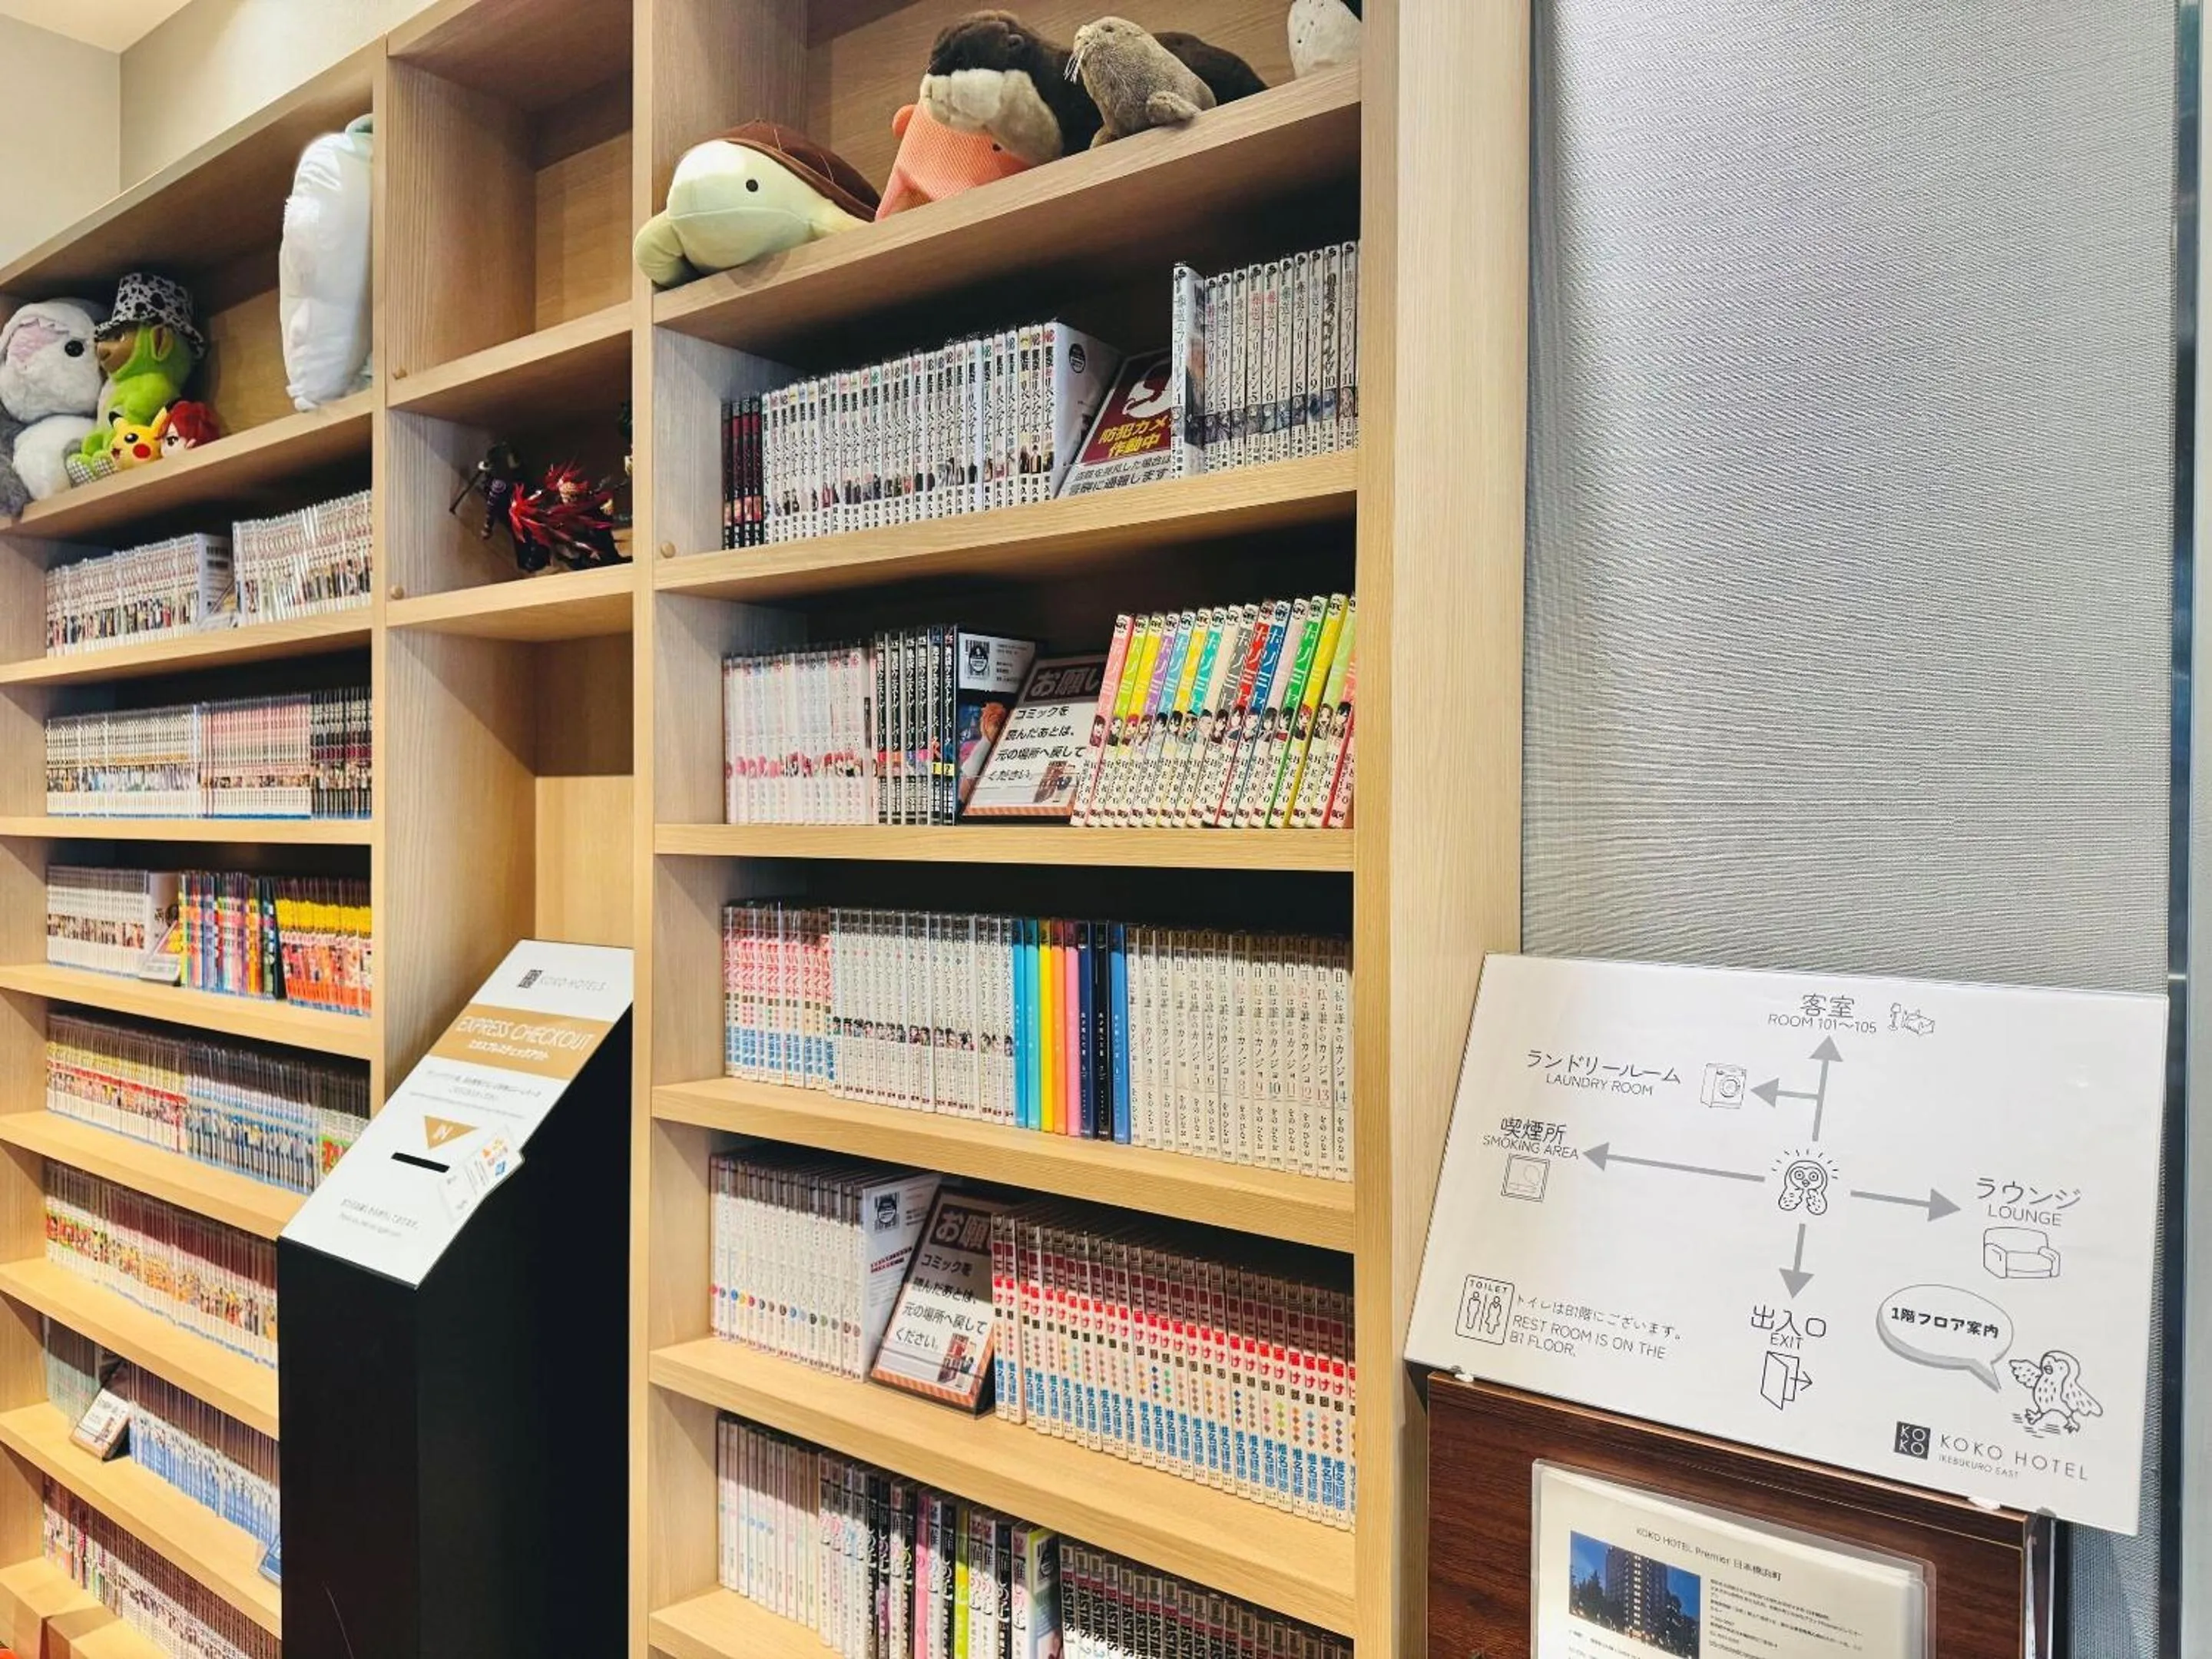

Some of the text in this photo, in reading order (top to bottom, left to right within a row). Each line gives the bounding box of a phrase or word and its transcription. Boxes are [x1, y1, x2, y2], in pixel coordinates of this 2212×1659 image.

[1295, 382, 1303, 393] 8
[1310, 379, 1318, 390] 9
[1098, 416, 1171, 445] 防犯カメ
[1108, 433, 1161, 458] 作動中
[1251, 625, 1283, 708] ホリミヤ
[1015, 705, 1071, 720] コミックを
[1005, 725, 1075, 741] 読んだあとは、
[995, 746, 1086, 761] 元の場所へ戻して
[1800, 994, 1855, 1018] 客室
[1769, 1014, 1813, 1028] ROOM
[456, 1018, 594, 1052] EXPRESS CHECKOUT
[1526, 1049, 1681, 1085] ランドリールーム
[1268, 1081, 1281, 1095] 10
[1335, 1089, 1346, 1104] 14
[1546, 1075, 1654, 1097] LAUNDRY ROOM
[1500, 1118, 1568, 1144] 喫煙所
[1482, 1134, 1579, 1161] SMOKING AREA
[1976, 1177, 2084, 1211] ラウンジ
[1987, 1205, 2063, 1227] LOUNGE
[935, 1211, 992, 1251] お願
[920, 1253, 974, 1277] コミックを
[913, 1277, 977, 1305] 読んだあとは、
[1469, 1280, 1508, 1294] TOILET
[902, 1303, 988, 1335] 元の場所へ戻して
[1750, 1306, 1828, 1339] 出入口
[1890, 1306, 1999, 1339] 1階フロア案内
[896, 1327, 939, 1350] ください。
[1508, 1330, 1577, 1358] B1 FLOOR.
[1512, 1315, 1667, 1360] REST ROOM IS ON THE
[1770, 1333, 1803, 1350] EXIT
[1939, 1434, 2088, 1482] KOKO HOTEL
[1995, 1465, 2019, 1479] EAST
[1061, 1571, 1075, 1632] BEASTARS
